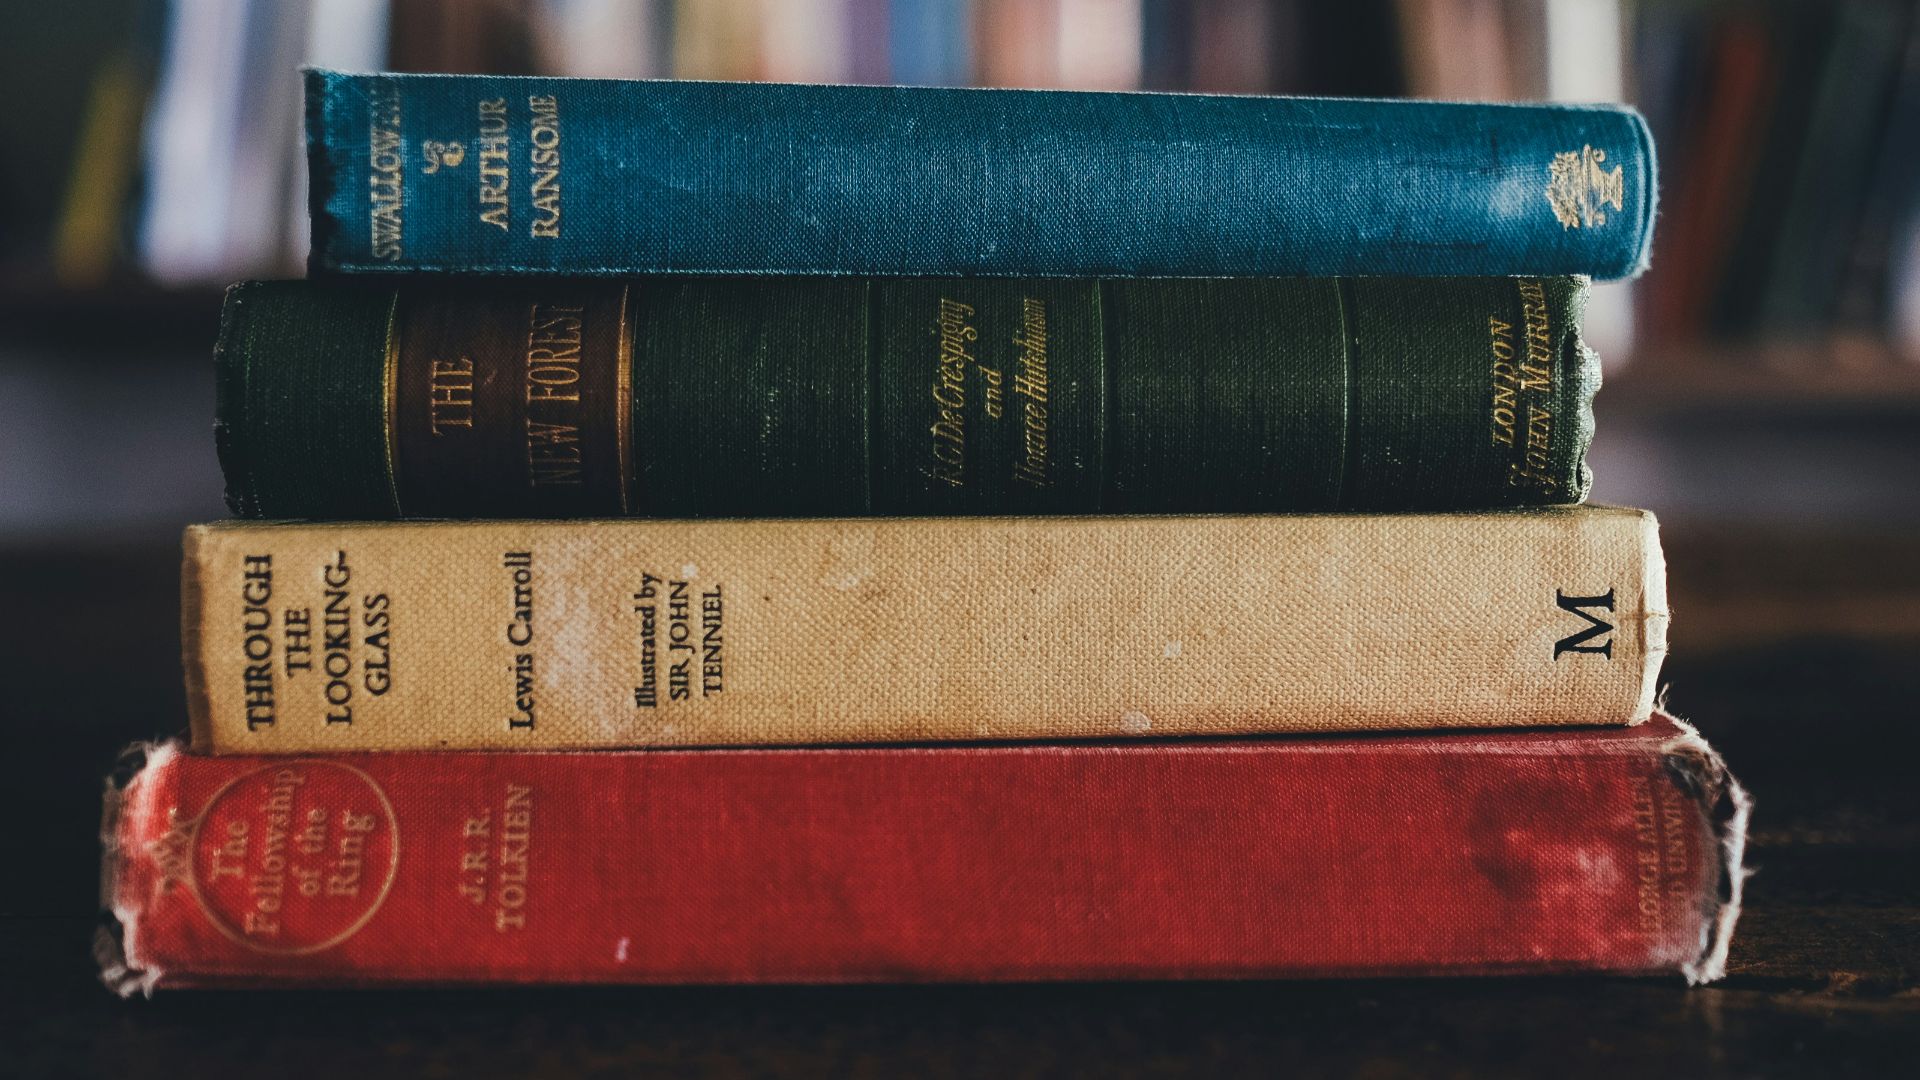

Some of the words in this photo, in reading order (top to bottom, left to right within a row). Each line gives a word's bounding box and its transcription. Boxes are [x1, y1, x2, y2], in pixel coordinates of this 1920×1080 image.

[479, 97, 509, 232] ARTHUR
[528, 94, 560, 239] RANSOME
[430, 355, 474, 437] THE
[526, 304, 584, 403] FOREST
[978, 365, 1003, 419] and
[1489, 313, 1518, 447] LONDON
[527, 417, 583, 488] NEW
[1509, 403, 1558, 495] JOHN
[503, 551, 534, 647] Carroll
[633, 571, 663, 600] by
[668, 579, 697, 655] JOHN
[1553, 586, 1615, 662] M
[243, 554, 275, 732] THROUGH
[284, 607, 312, 679] THE
[324, 549, 353, 727] LOOKING-
[363, 592, 392, 697] GLASS
[633, 604, 657, 709] Illustrated
[668, 657, 691, 702] SIR
[701, 583, 724, 698] TENNIEL
[506, 652, 536, 732] Lewis
[209, 820, 250, 882] The
[244, 768, 305, 936] Fellowship
[293, 807, 328, 855] the
[327, 808, 376, 897] Ring
[495, 783, 533, 934] TOLKIEN
[291, 864, 323, 897] of
